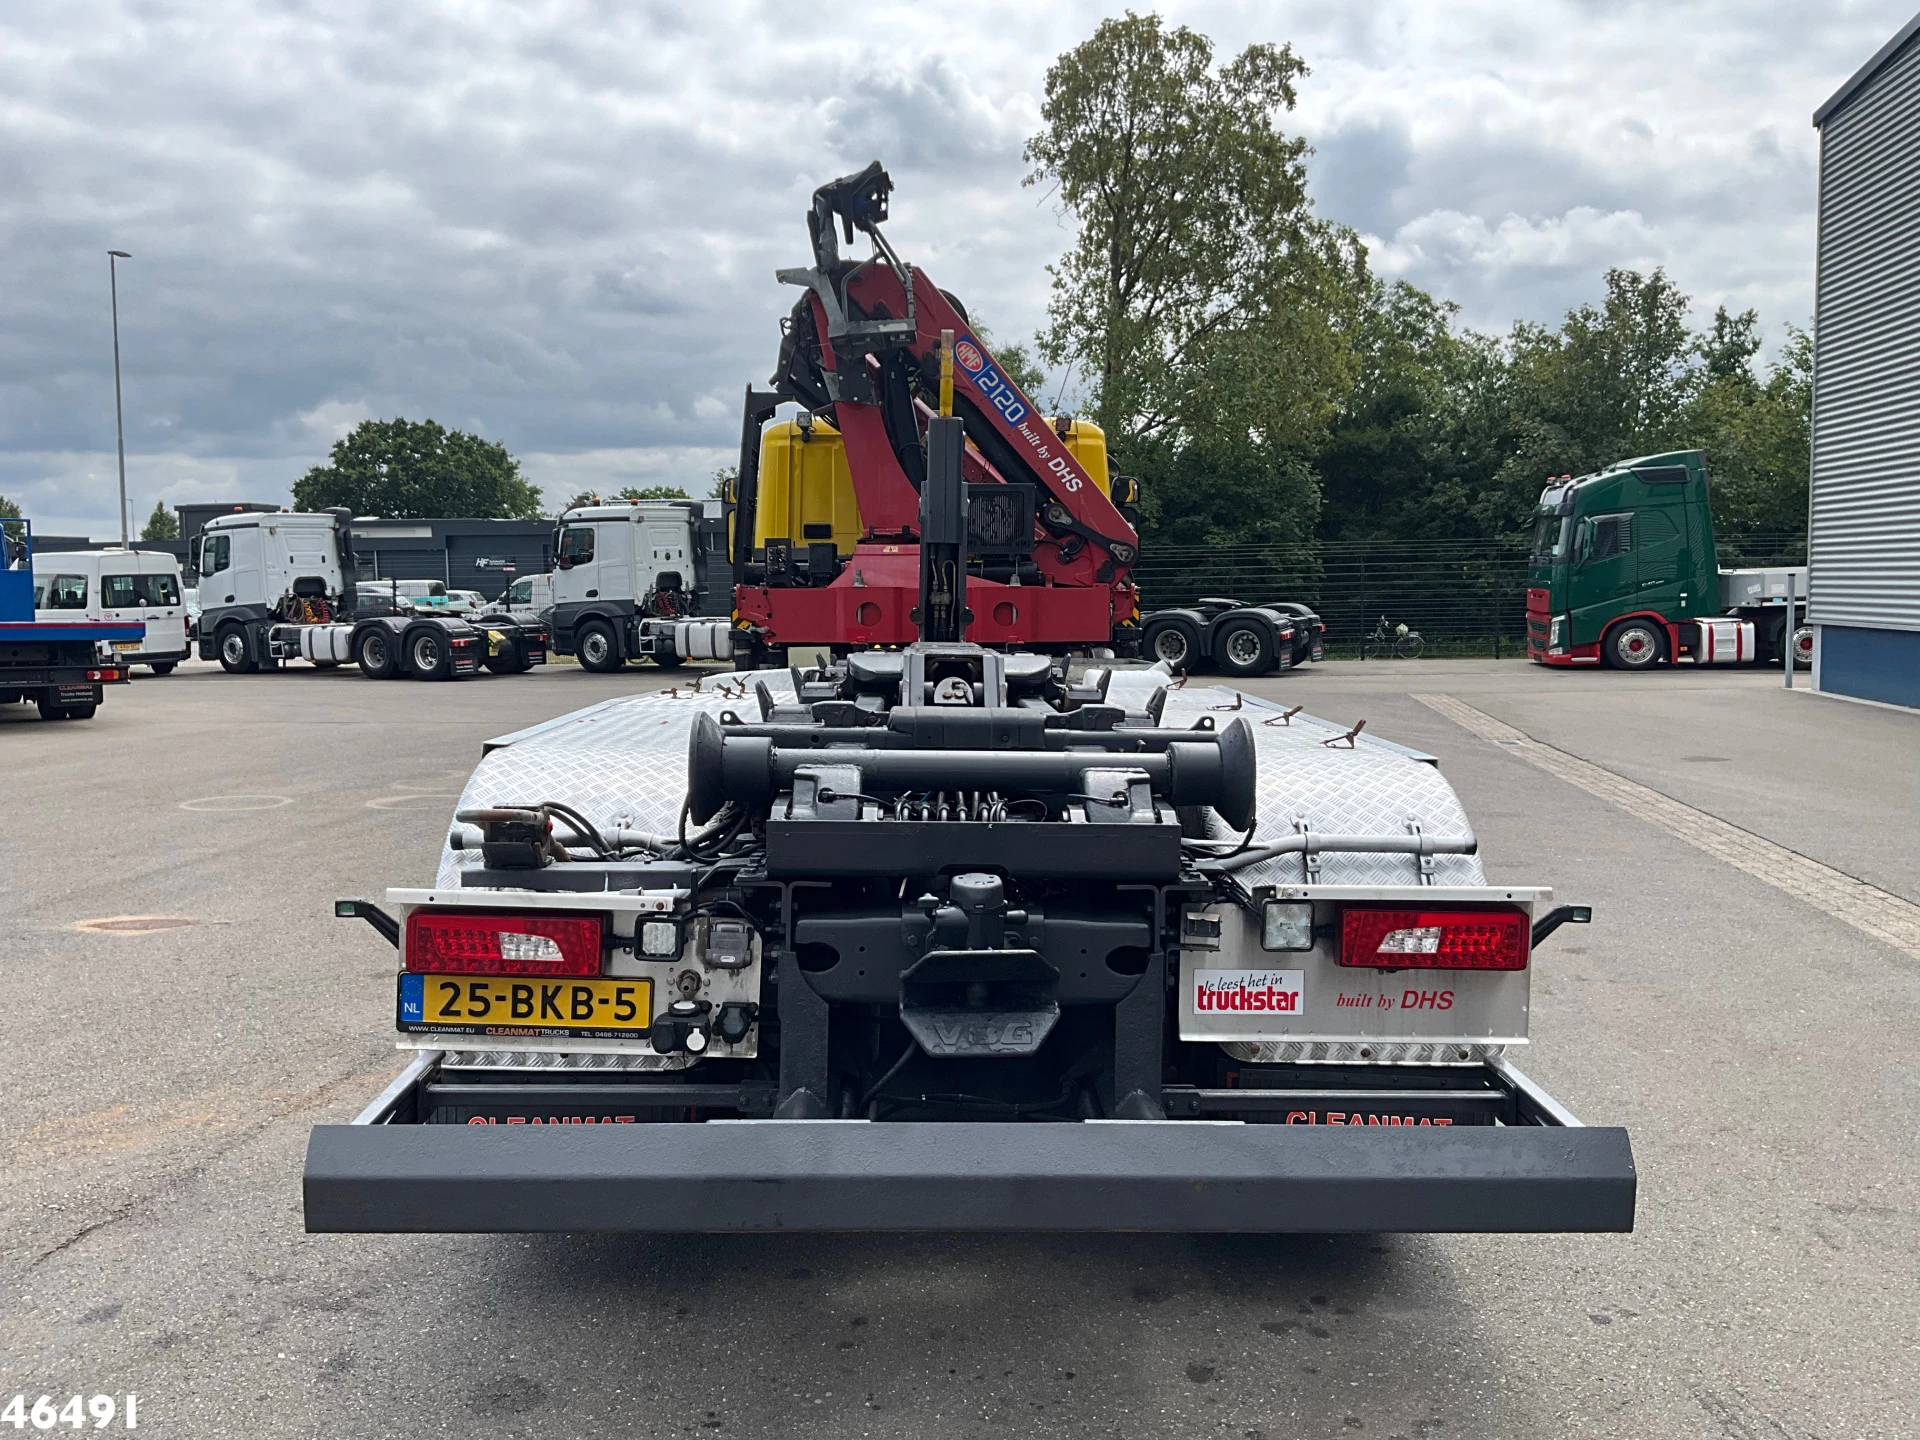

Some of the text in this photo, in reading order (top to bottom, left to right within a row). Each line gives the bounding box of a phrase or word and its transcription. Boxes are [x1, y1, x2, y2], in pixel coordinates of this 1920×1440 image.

[958, 345, 1025, 422] HMF 2120
[1017, 422, 1083, 493] built by DHS
[1217, 976, 1245, 991] leest
[1247, 973, 1267, 988] het
[1270, 973, 1283, 985] in
[404, 1002, 421, 1014] NL
[438, 981, 638, 1022] 25-BKB-5
[1197, 985, 1299, 1011] truckstar
[1336, 989, 1455, 1011] built by DHS
[408, 1025, 475, 1034] WWW.CLEANMAT.EU
[485, 1026, 540, 1037] CLEANMAT
